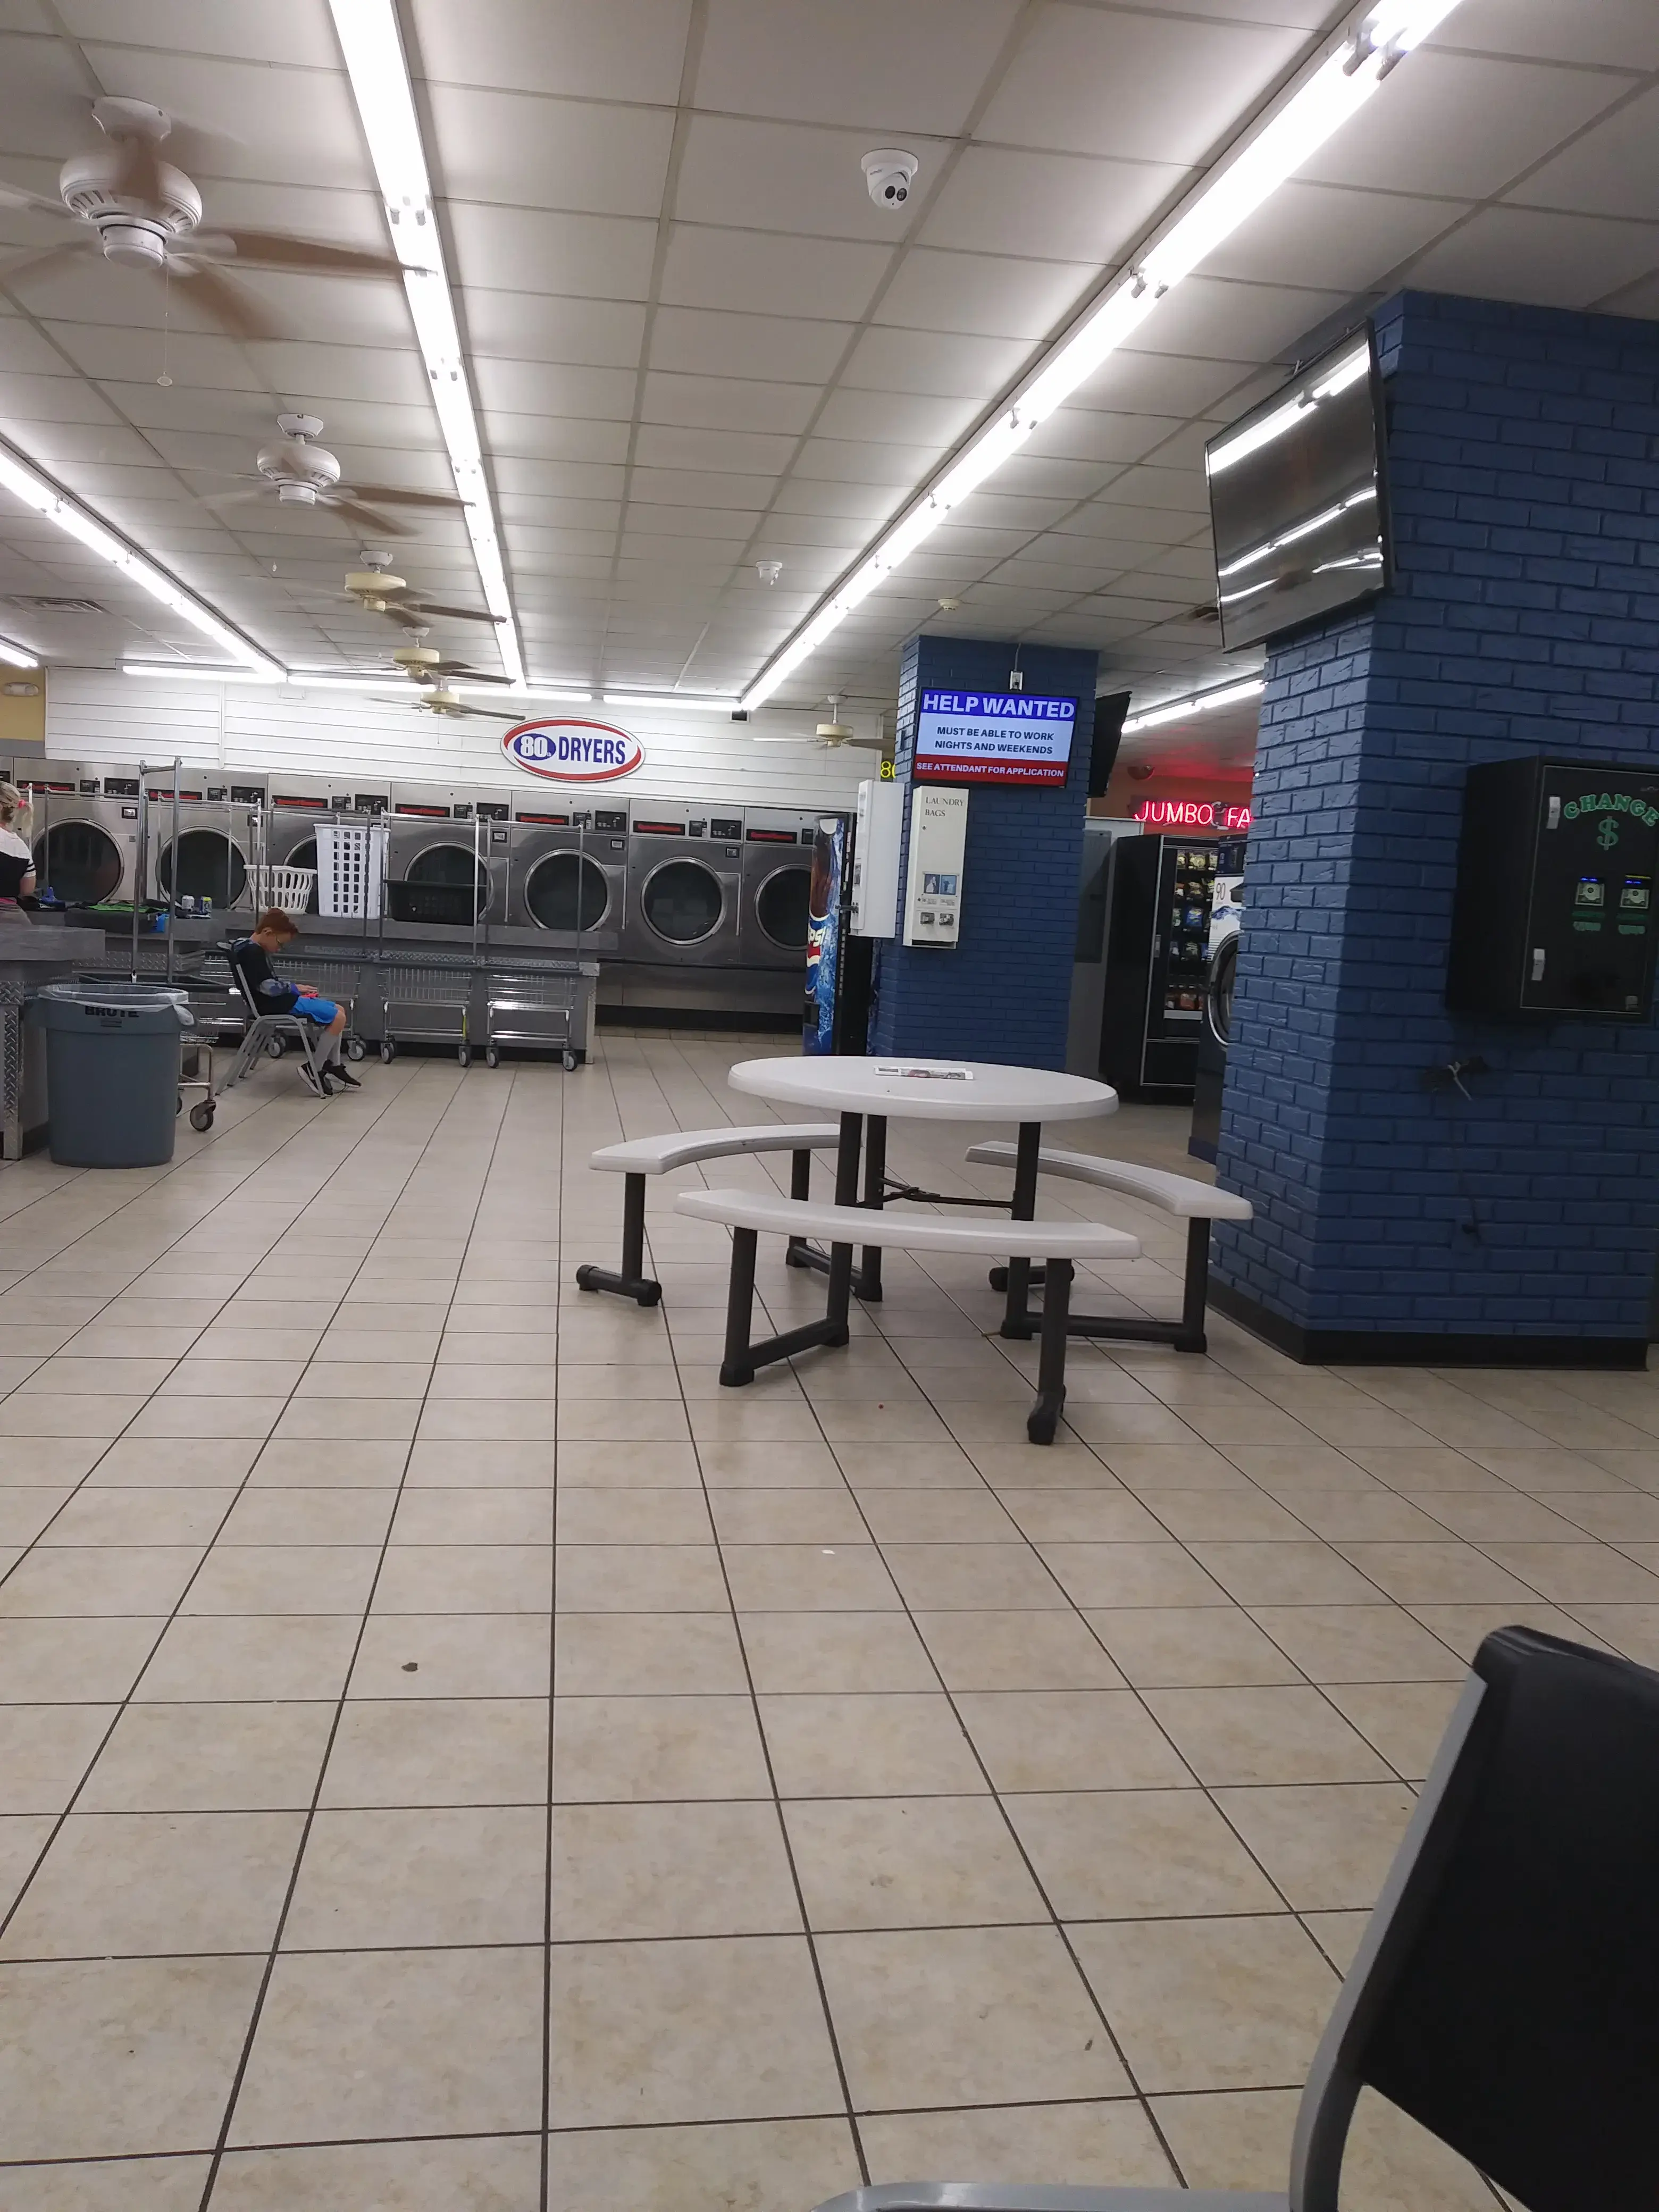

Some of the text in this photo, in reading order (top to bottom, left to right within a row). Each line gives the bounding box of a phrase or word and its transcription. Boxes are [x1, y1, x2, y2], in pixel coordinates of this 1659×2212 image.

[923, 693, 1075, 718] HELP WANTED
[937, 726, 1054, 741] MUST BE ABLE TO WORK
[520, 735, 548, 757] 80
[558, 736, 626, 765] DRYERS
[935, 740, 1053, 755] NIGHTS AND WEEKENDS
[916, 762, 933, 770] SEE
[934, 764, 987, 773] ATTENDANT
[1006, 767, 1064, 777] APPLICATION
[926, 797, 964, 806] LAUNDRY
[1564, 793, 1659, 827] CHANGE
[1134, 801, 1213, 825] JUMBO
[1216, 883, 1226, 901] 90
